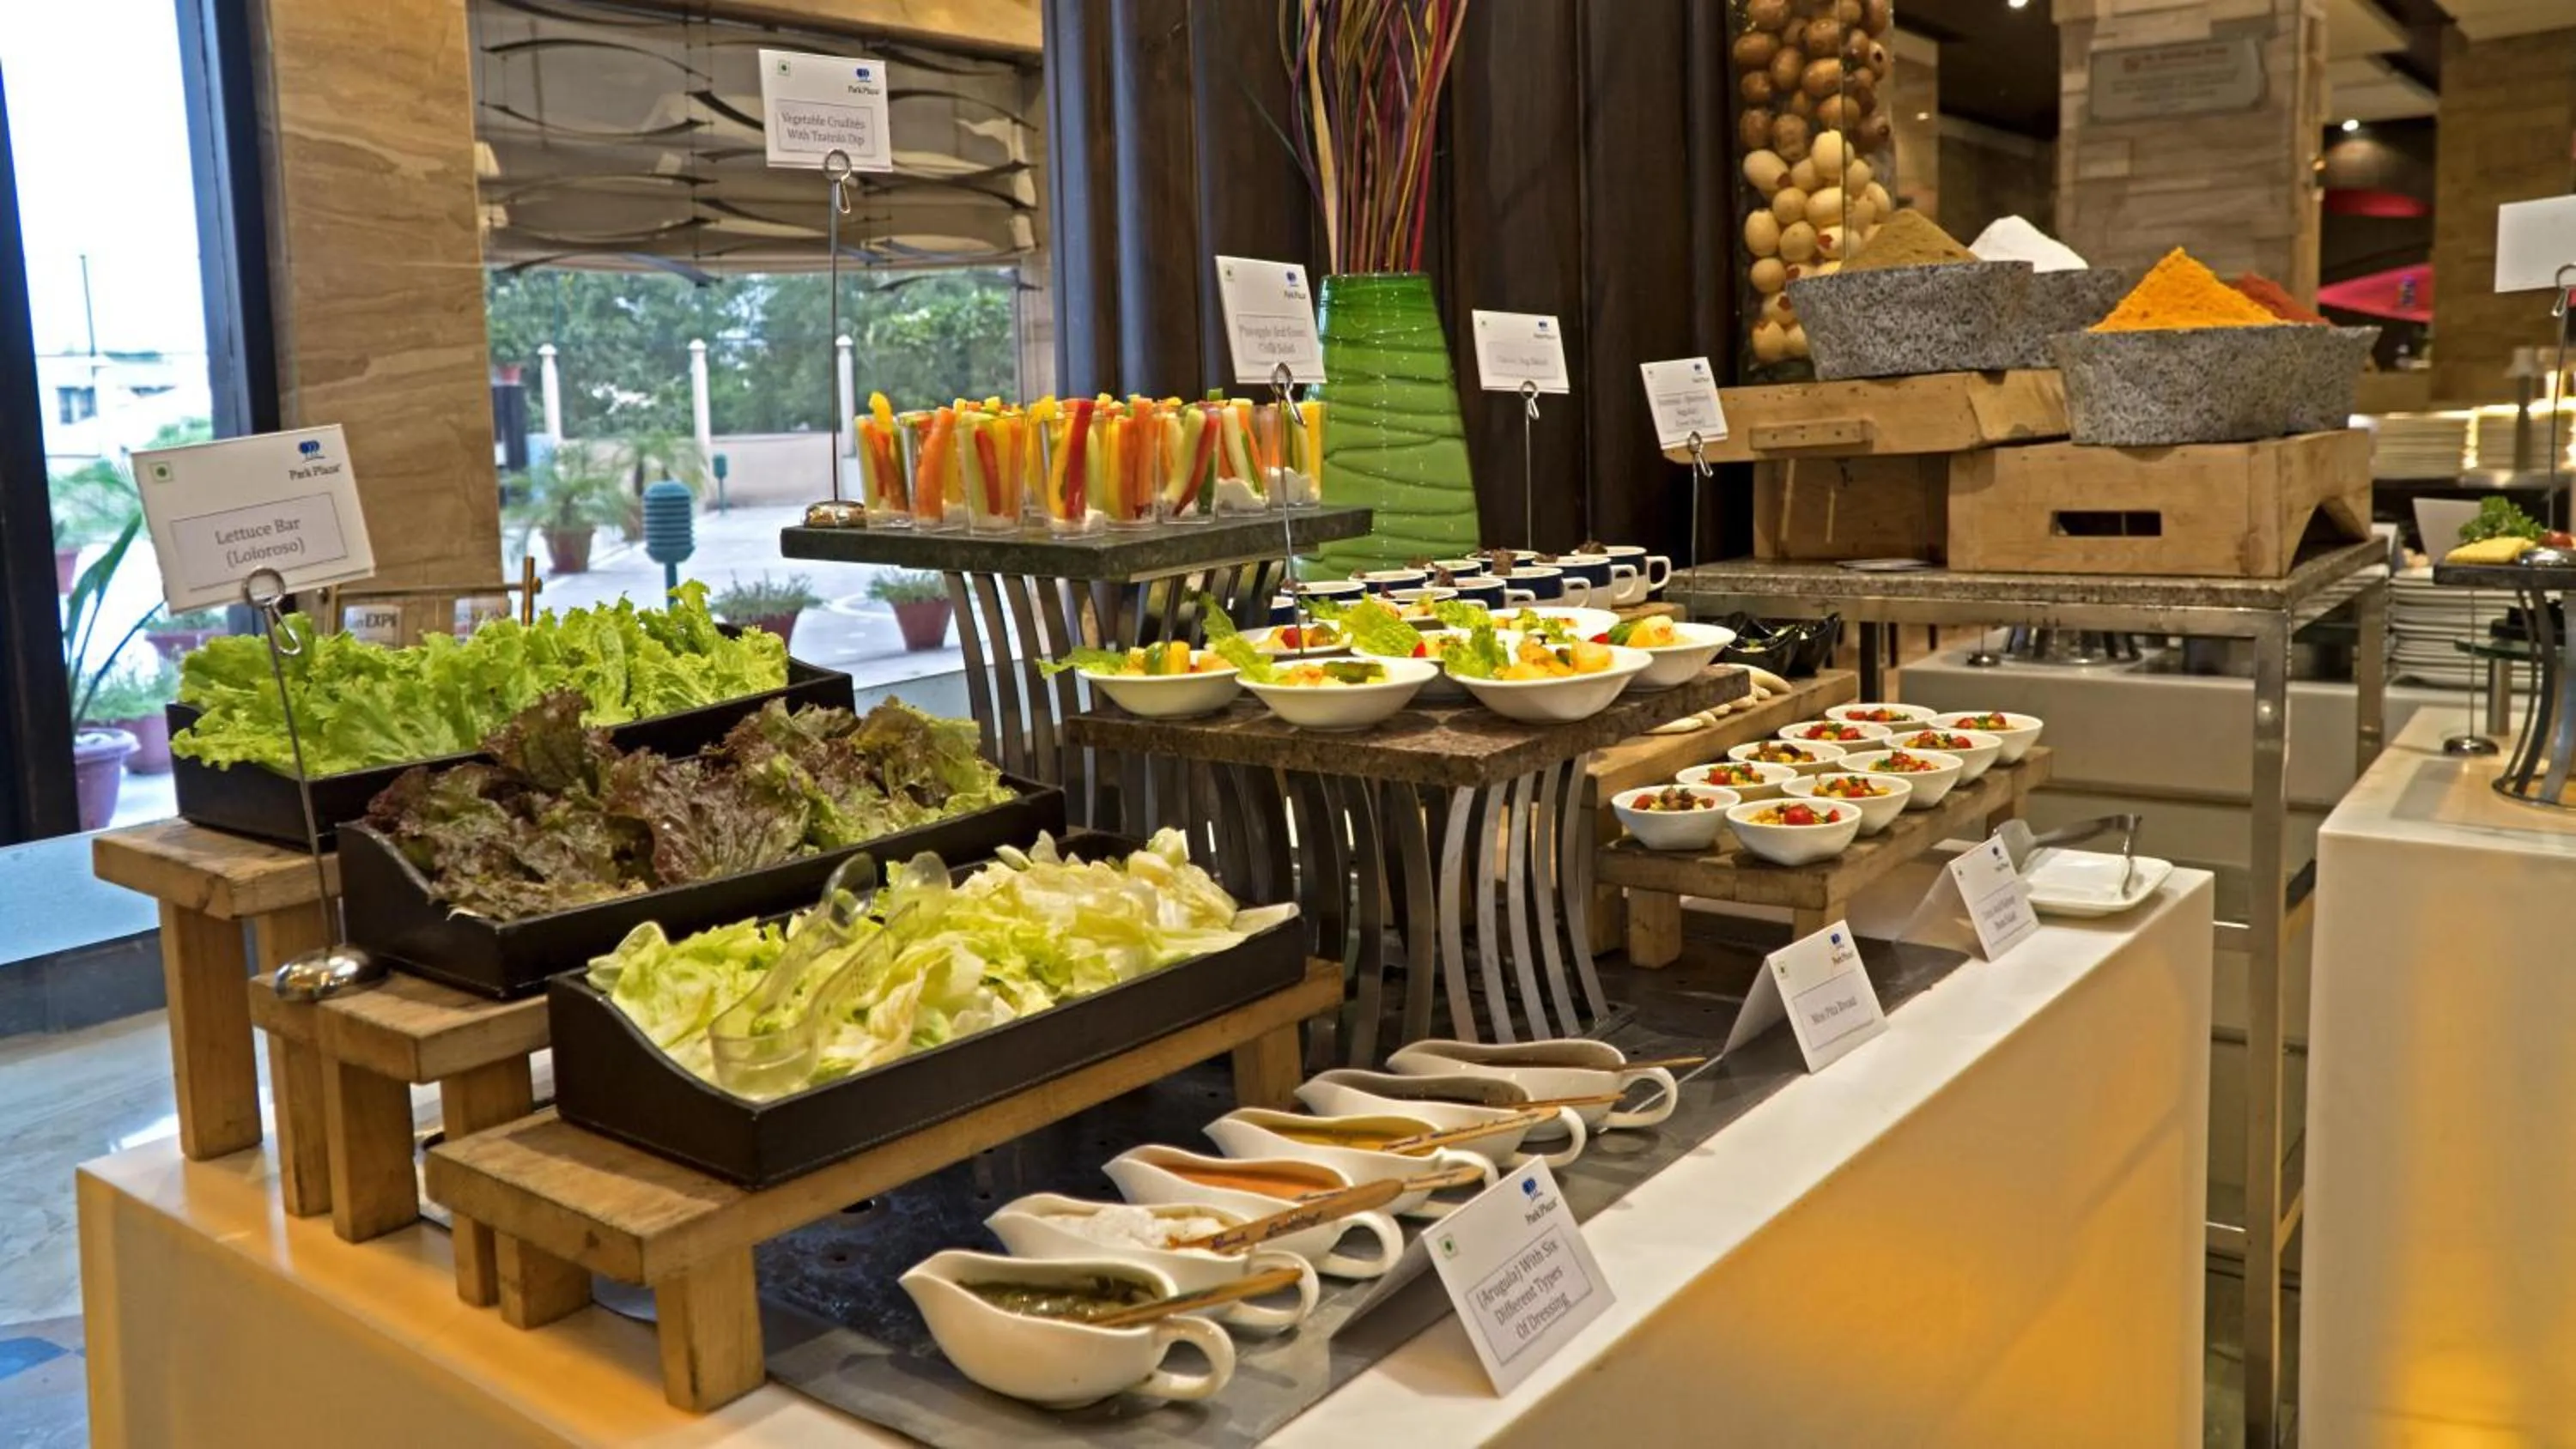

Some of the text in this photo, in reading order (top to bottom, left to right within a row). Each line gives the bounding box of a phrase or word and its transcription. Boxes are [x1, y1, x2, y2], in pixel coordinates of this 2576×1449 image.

[781, 112, 826, 126] Vegetable
[787, 129, 810, 140] With
[289, 468, 312, 482] Park
[215, 518, 301, 545] Lettuce Bar
[1519, 1250, 1545, 1275] With
[1543, 1240, 1558, 1258] Six
[1494, 1265, 1564, 1325] Different Types
[1516, 1292, 1571, 1340] Of Dressing
